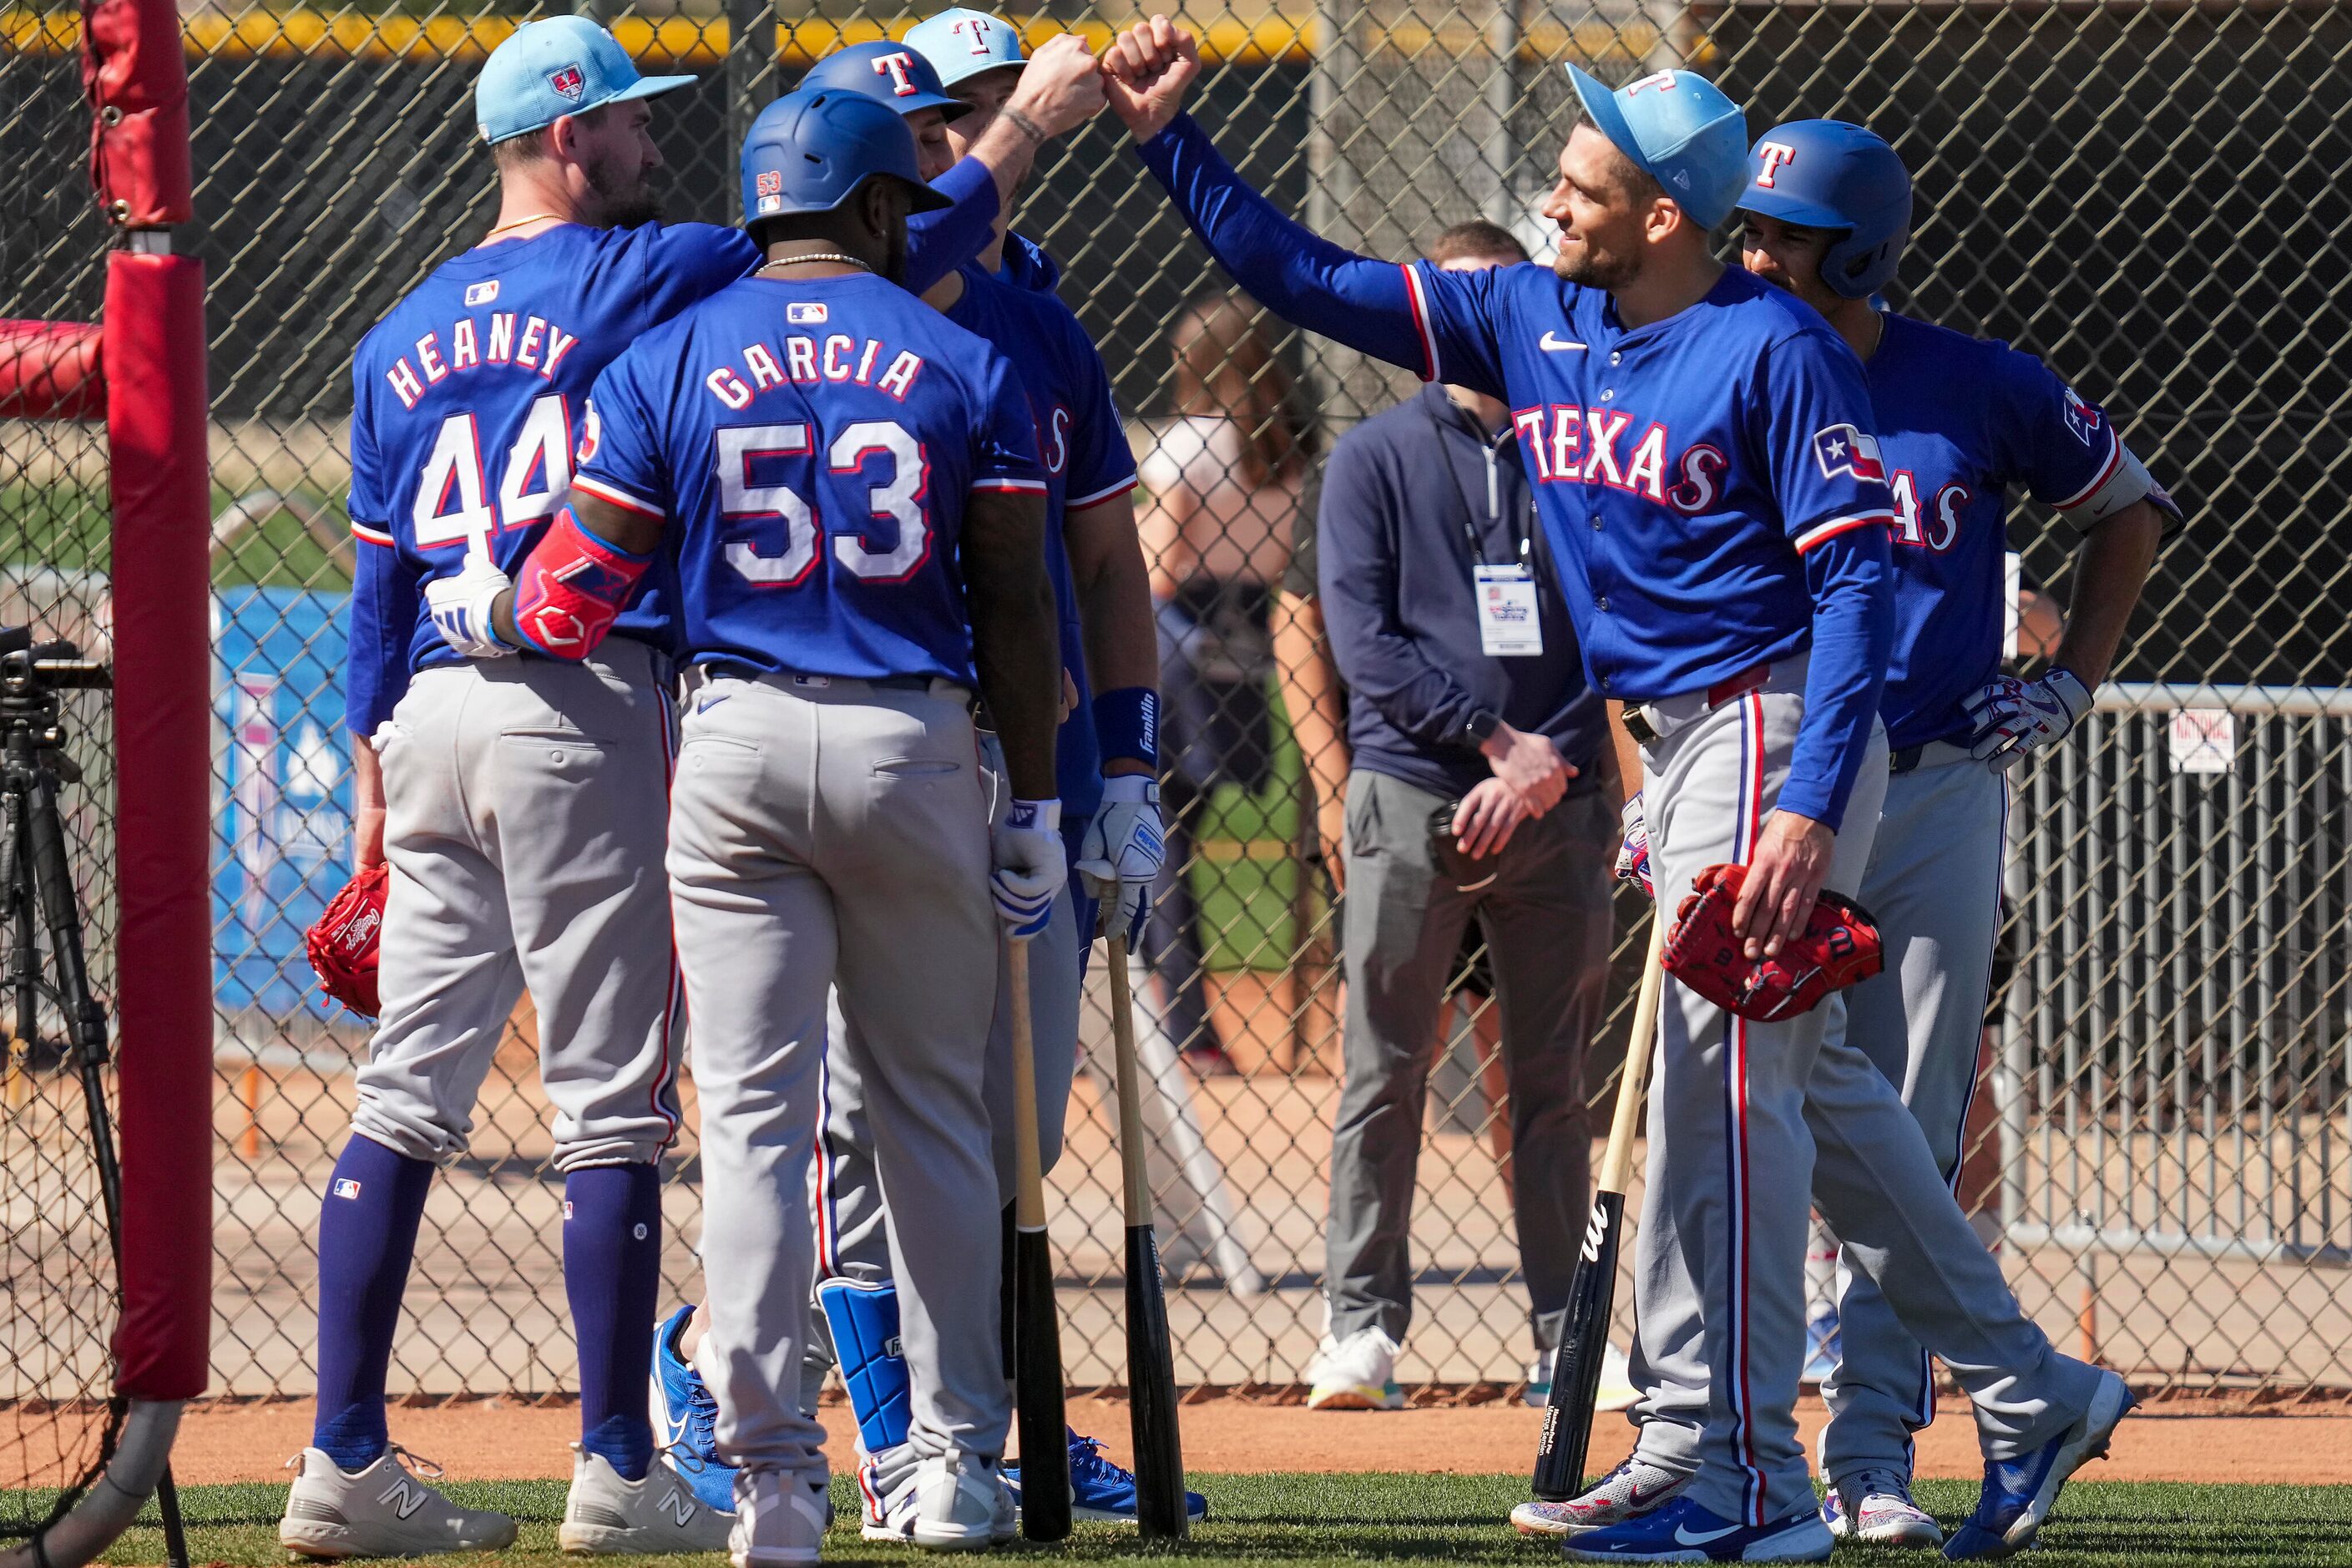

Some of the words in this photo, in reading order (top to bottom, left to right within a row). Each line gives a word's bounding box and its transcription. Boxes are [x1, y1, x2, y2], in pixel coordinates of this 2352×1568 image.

[948, 19, 991, 55] T
[871, 51, 918, 98] T
[756, 170, 781, 196] 53
[1756, 140, 1797, 190] T
[385, 313, 579, 411] HEANEY
[706, 334, 923, 411] GARCIA
[411, 391, 578, 564] 44
[1510, 403, 1729, 518] TEXAS
[713, 419, 932, 588] 53
[1543, 1405, 1555, 1430] Marcus
